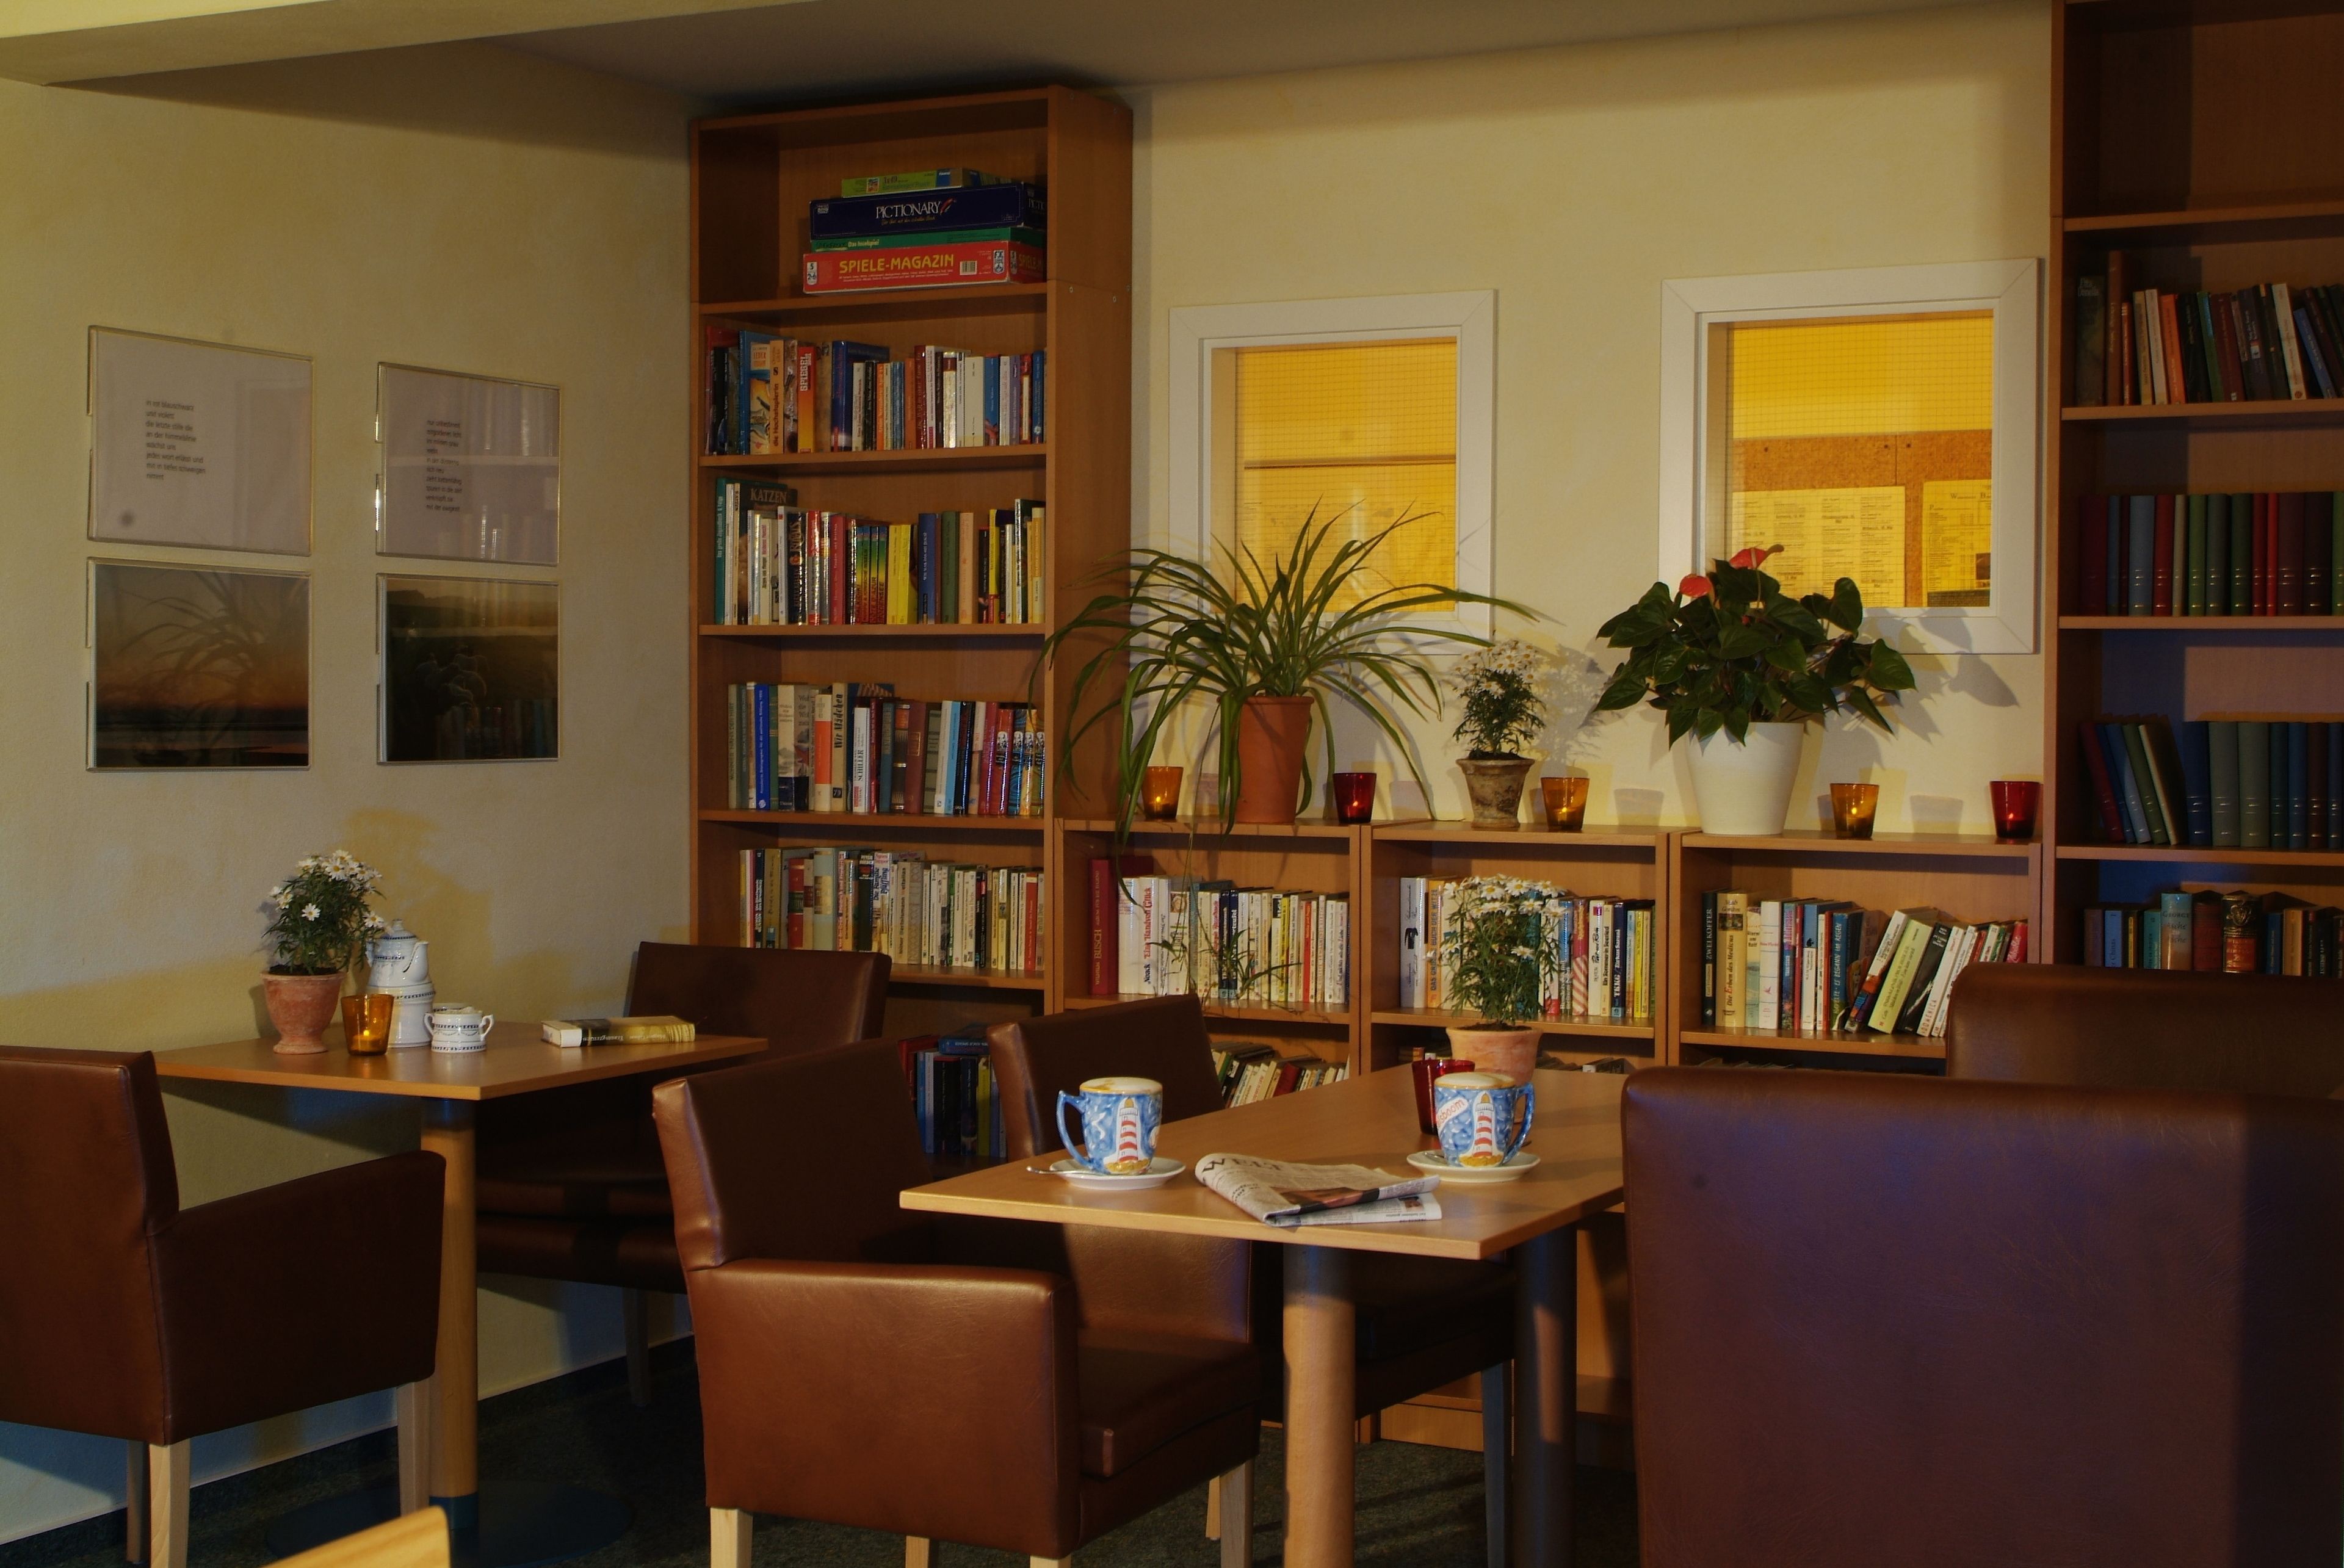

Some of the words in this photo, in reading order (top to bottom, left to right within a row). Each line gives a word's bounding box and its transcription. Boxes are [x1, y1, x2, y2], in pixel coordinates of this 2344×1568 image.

[876, 200, 941, 219] PICTIONARY
[839, 254, 954, 273] SPIELE-MAGAZIN
[750, 488, 787, 504] KATZEN
[833, 694, 843, 730] Mädchen
[834, 734, 842, 748] Wir
[1724, 974, 1733, 994] Erben
[1202, 1157, 1281, 1173] WELT
